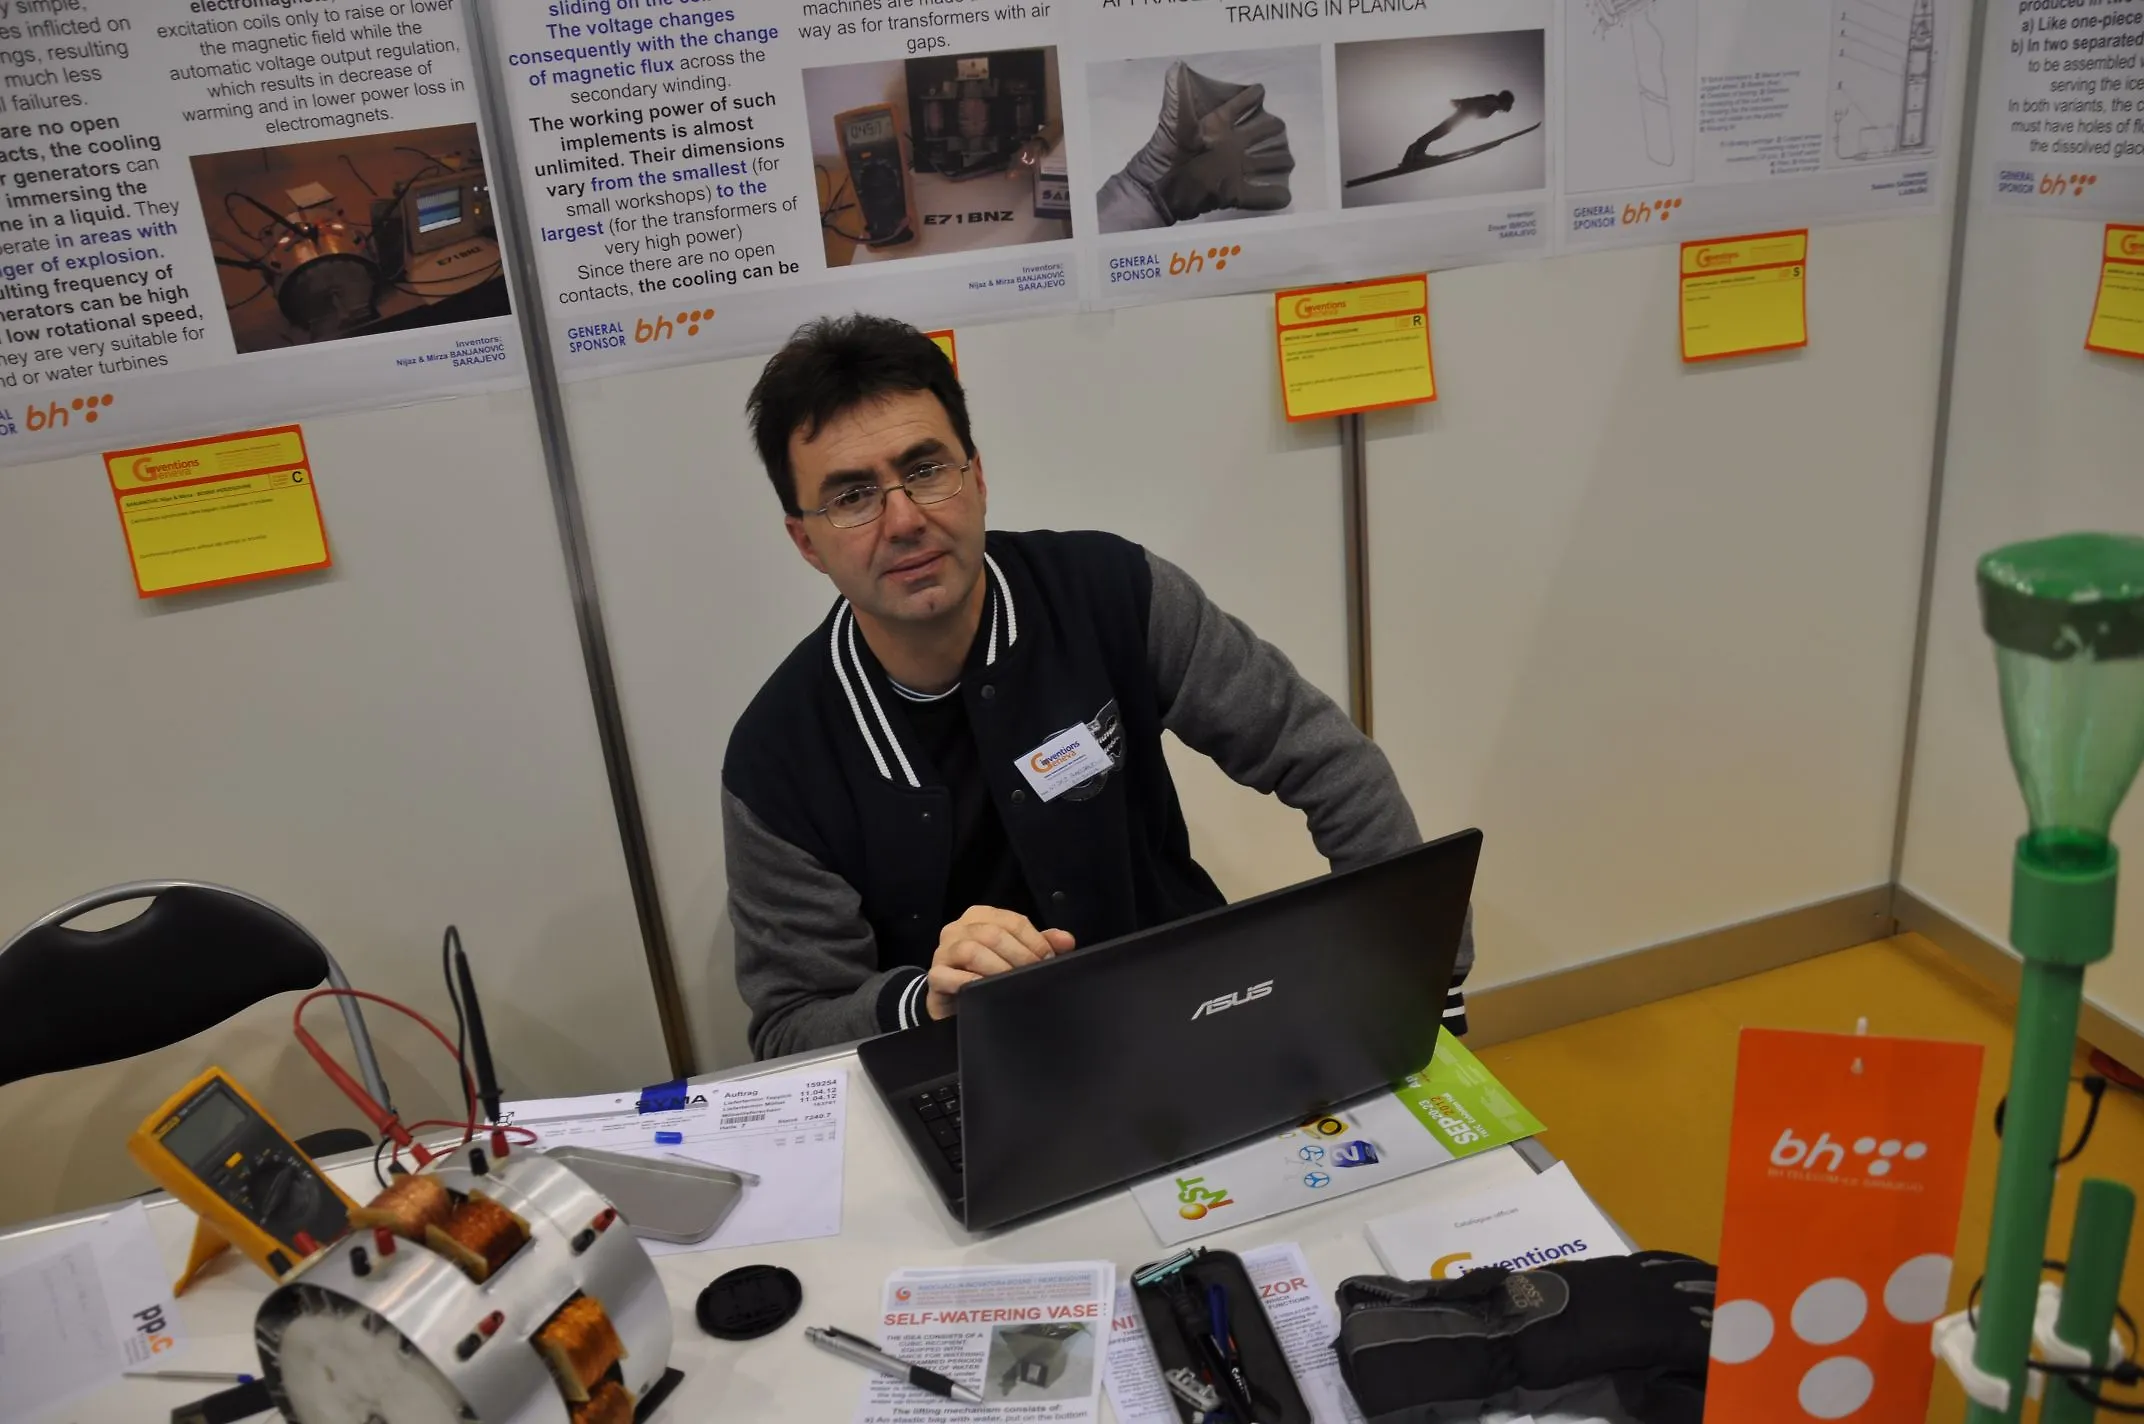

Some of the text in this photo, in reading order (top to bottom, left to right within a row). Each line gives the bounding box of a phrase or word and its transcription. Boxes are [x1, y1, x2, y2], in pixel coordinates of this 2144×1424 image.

[157, 0, 453, 38] excitation coils only to raise or lower
[549, 0, 611, 17] sliding
[799, 3, 1051, 40] way as for transformers with air
[1225, 0, 1427, 23] TRAINING IN PLANICA
[546, 8, 735, 39] The voltage changes
[2038, 16, 2067, 32] Like
[200, 20, 423, 57] the magnetic field while the
[509, 26, 779, 66] consequently with the change
[907, 35, 950, 54] gaps.
[2027, 38, 2040, 52] In
[2044, 38, 2068, 51] two
[170, 38, 460, 81] automatic voltage output regulation,
[529, 48, 766, 86] of magnetic flux across the
[182, 78, 465, 122] warming and in lower power loss in
[570, 74, 731, 103] secondary winding.
[265, 108, 394, 134] electromagnets.
[529, 92, 776, 133] The working power of such
[560, 116, 754, 152] implements is almost
[534, 135, 785, 176] unlimited. Their dimensions
[547, 156, 780, 198] vary from the smallest (for
[566, 180, 767, 217] small workshops) to the
[1573, 205, 1615, 218] GENERAL
[541, 196, 799, 243] largest (for the transformers of
[924, 211, 1014, 225] E71BNZ
[1573, 217, 1615, 230] SPONSOR
[1621, 202, 1650, 225] bh
[577, 243, 775, 281] Since there are no open
[1022, 263, 1063, 273] Inventors:
[1109, 254, 1160, 270] GENERAL
[1110, 267, 1161, 283] SPONSOR
[1169, 250, 1203, 276] bh
[1792, 266, 1800, 277] S
[559, 260, 799, 305] contacts, the cooling can be
[995, 277, 1015, 285] Mirza
[1018, 279, 1065, 291] SARAJEVO
[6, 304, 204, 343] low rotational speed,
[568, 322, 624, 339] GENERAL
[634, 315, 673, 344] bh
[1413, 315, 1422, 326] R
[34, 326, 205, 362] are very suitable for
[456, 336, 502, 348] Inventors:
[569, 336, 626, 353] SPONSOR
[22, 353, 169, 385] or water turbines
[426, 353, 448, 362] Mirza
[453, 352, 506, 367] SARAJEVO
[26, 401, 69, 431] bh
[292, 471, 303, 483] C
[1191, 980, 1274, 1020] ASUS
[725, 1090, 758, 1098] Auftrag
[1438, 1117, 1479, 1145] SEP
[1770, 1128, 1844, 1172] bh
[1259, 1277, 1308, 1298] ZOR
[884, 1303, 1098, 1326] SELF-WATERING VASE
